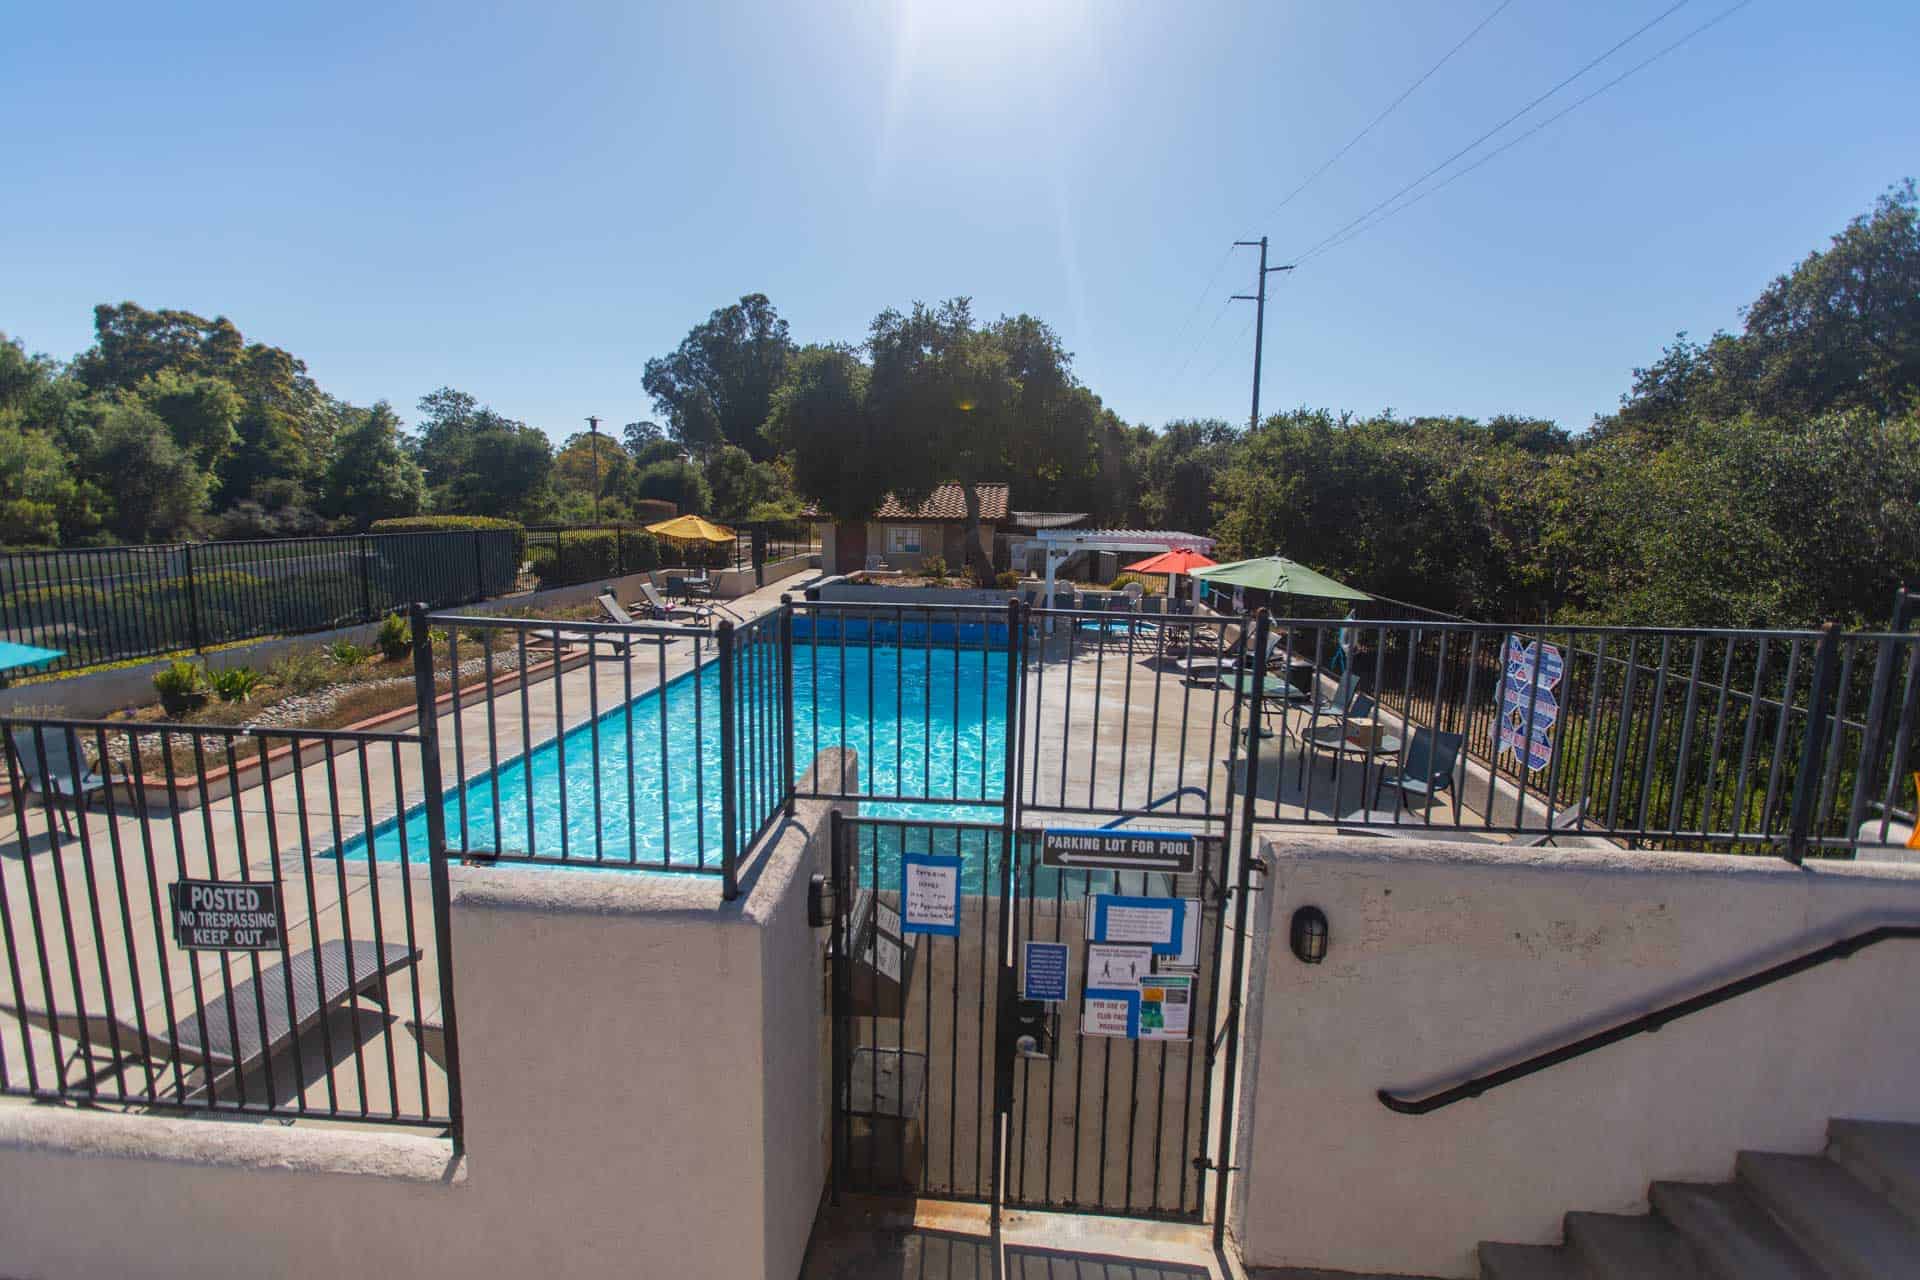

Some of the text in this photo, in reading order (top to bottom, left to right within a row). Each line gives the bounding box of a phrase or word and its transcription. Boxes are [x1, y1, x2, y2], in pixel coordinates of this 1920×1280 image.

[1048, 836, 1190, 855] PARKING LOT FOR POOL
[191, 886, 259, 911] POSTED
[180, 911, 276, 928] NO TRESPASSING
[193, 929, 229, 945] KEEP
[234, 930, 263, 945] OUT
